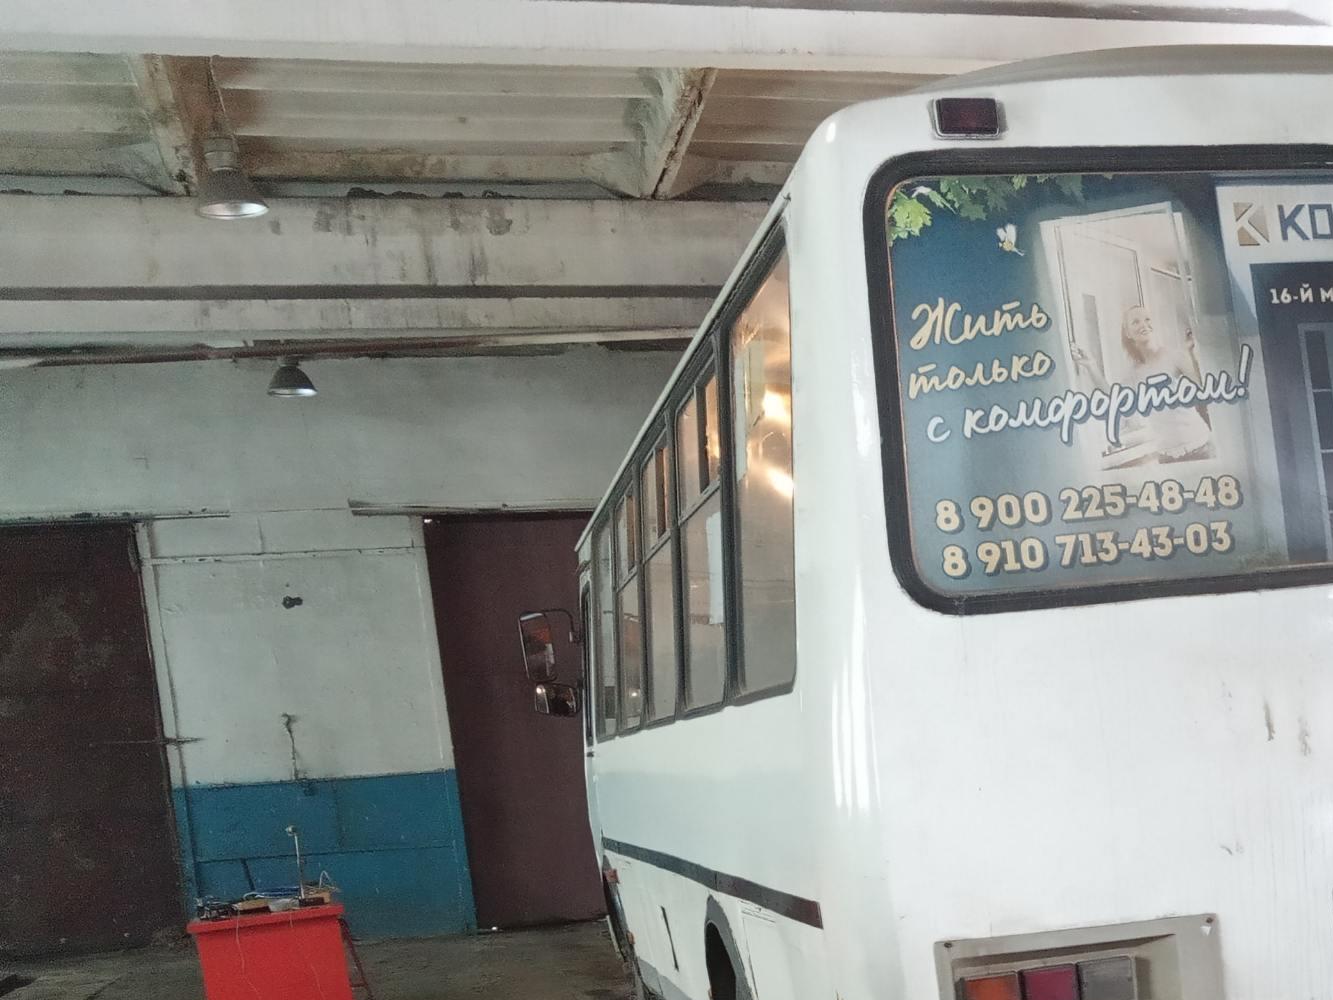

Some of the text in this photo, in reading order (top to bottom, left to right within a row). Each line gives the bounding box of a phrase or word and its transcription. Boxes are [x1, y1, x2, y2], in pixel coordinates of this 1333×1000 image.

[1270, 283, 1313, 304] 16-Й
[909, 297, 1050, 351] Жить
[908, 351, 1053, 399] только
[926, 345, 1252, 444] с комфортом!
[935, 476, 1240, 532] 8 900 225-48-48
[943, 522, 1232, 577] 8 910 713-43-03
